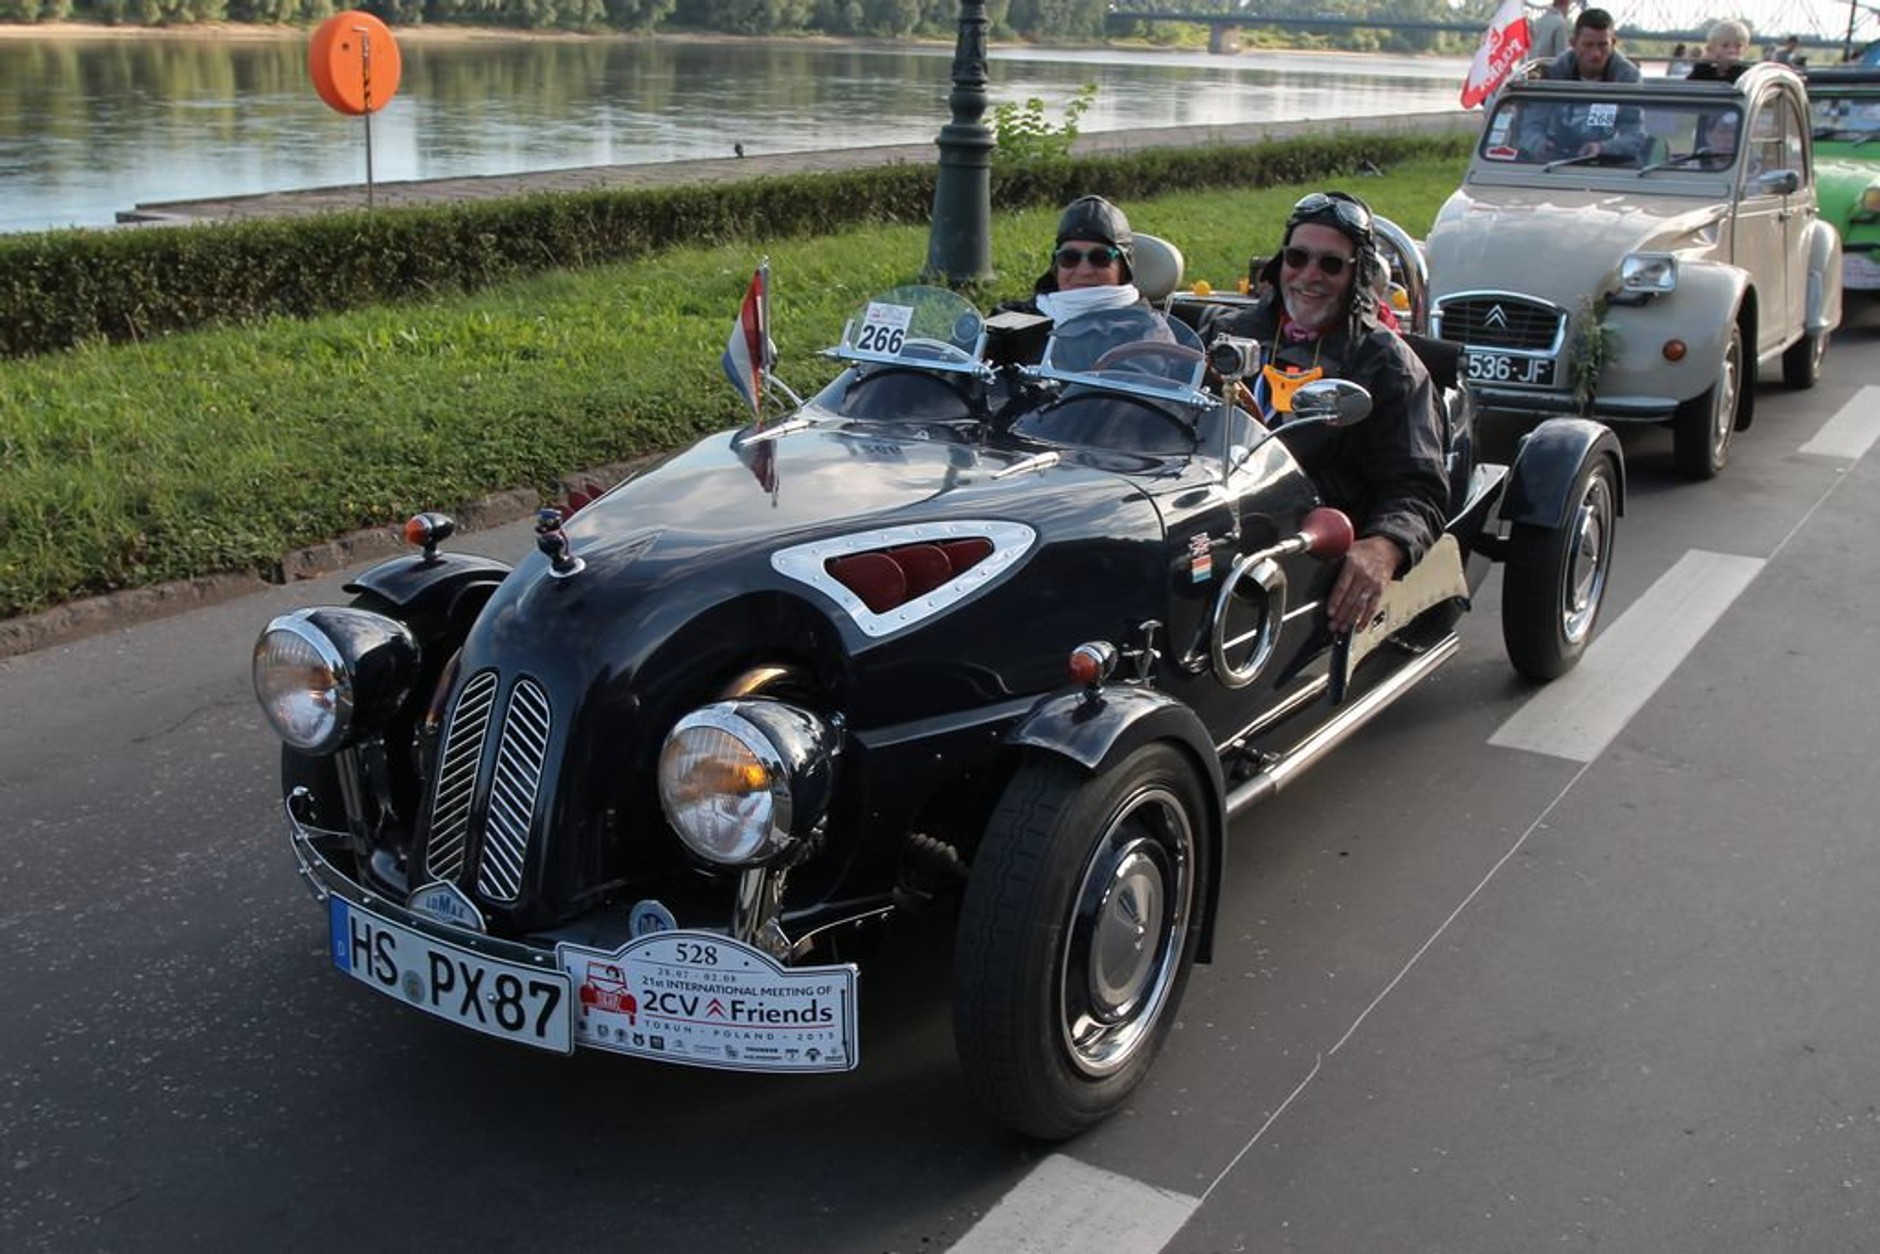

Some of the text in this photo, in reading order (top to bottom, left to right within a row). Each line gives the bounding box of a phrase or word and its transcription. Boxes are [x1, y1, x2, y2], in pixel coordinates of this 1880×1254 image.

[1589, 112, 1614, 125] 268
[858, 325, 904, 354] 266
[1468, 353, 1511, 380] 536
[350, 916, 399, 987] HS
[675, 943, 718, 966] 528
[642, 975, 833, 997] 21st INTERNATIONAL MEETING OF
[642, 990, 700, 1017] 2CV
[730, 999, 834, 1023] Friends
[713, 1029, 775, 1041] POLAND
